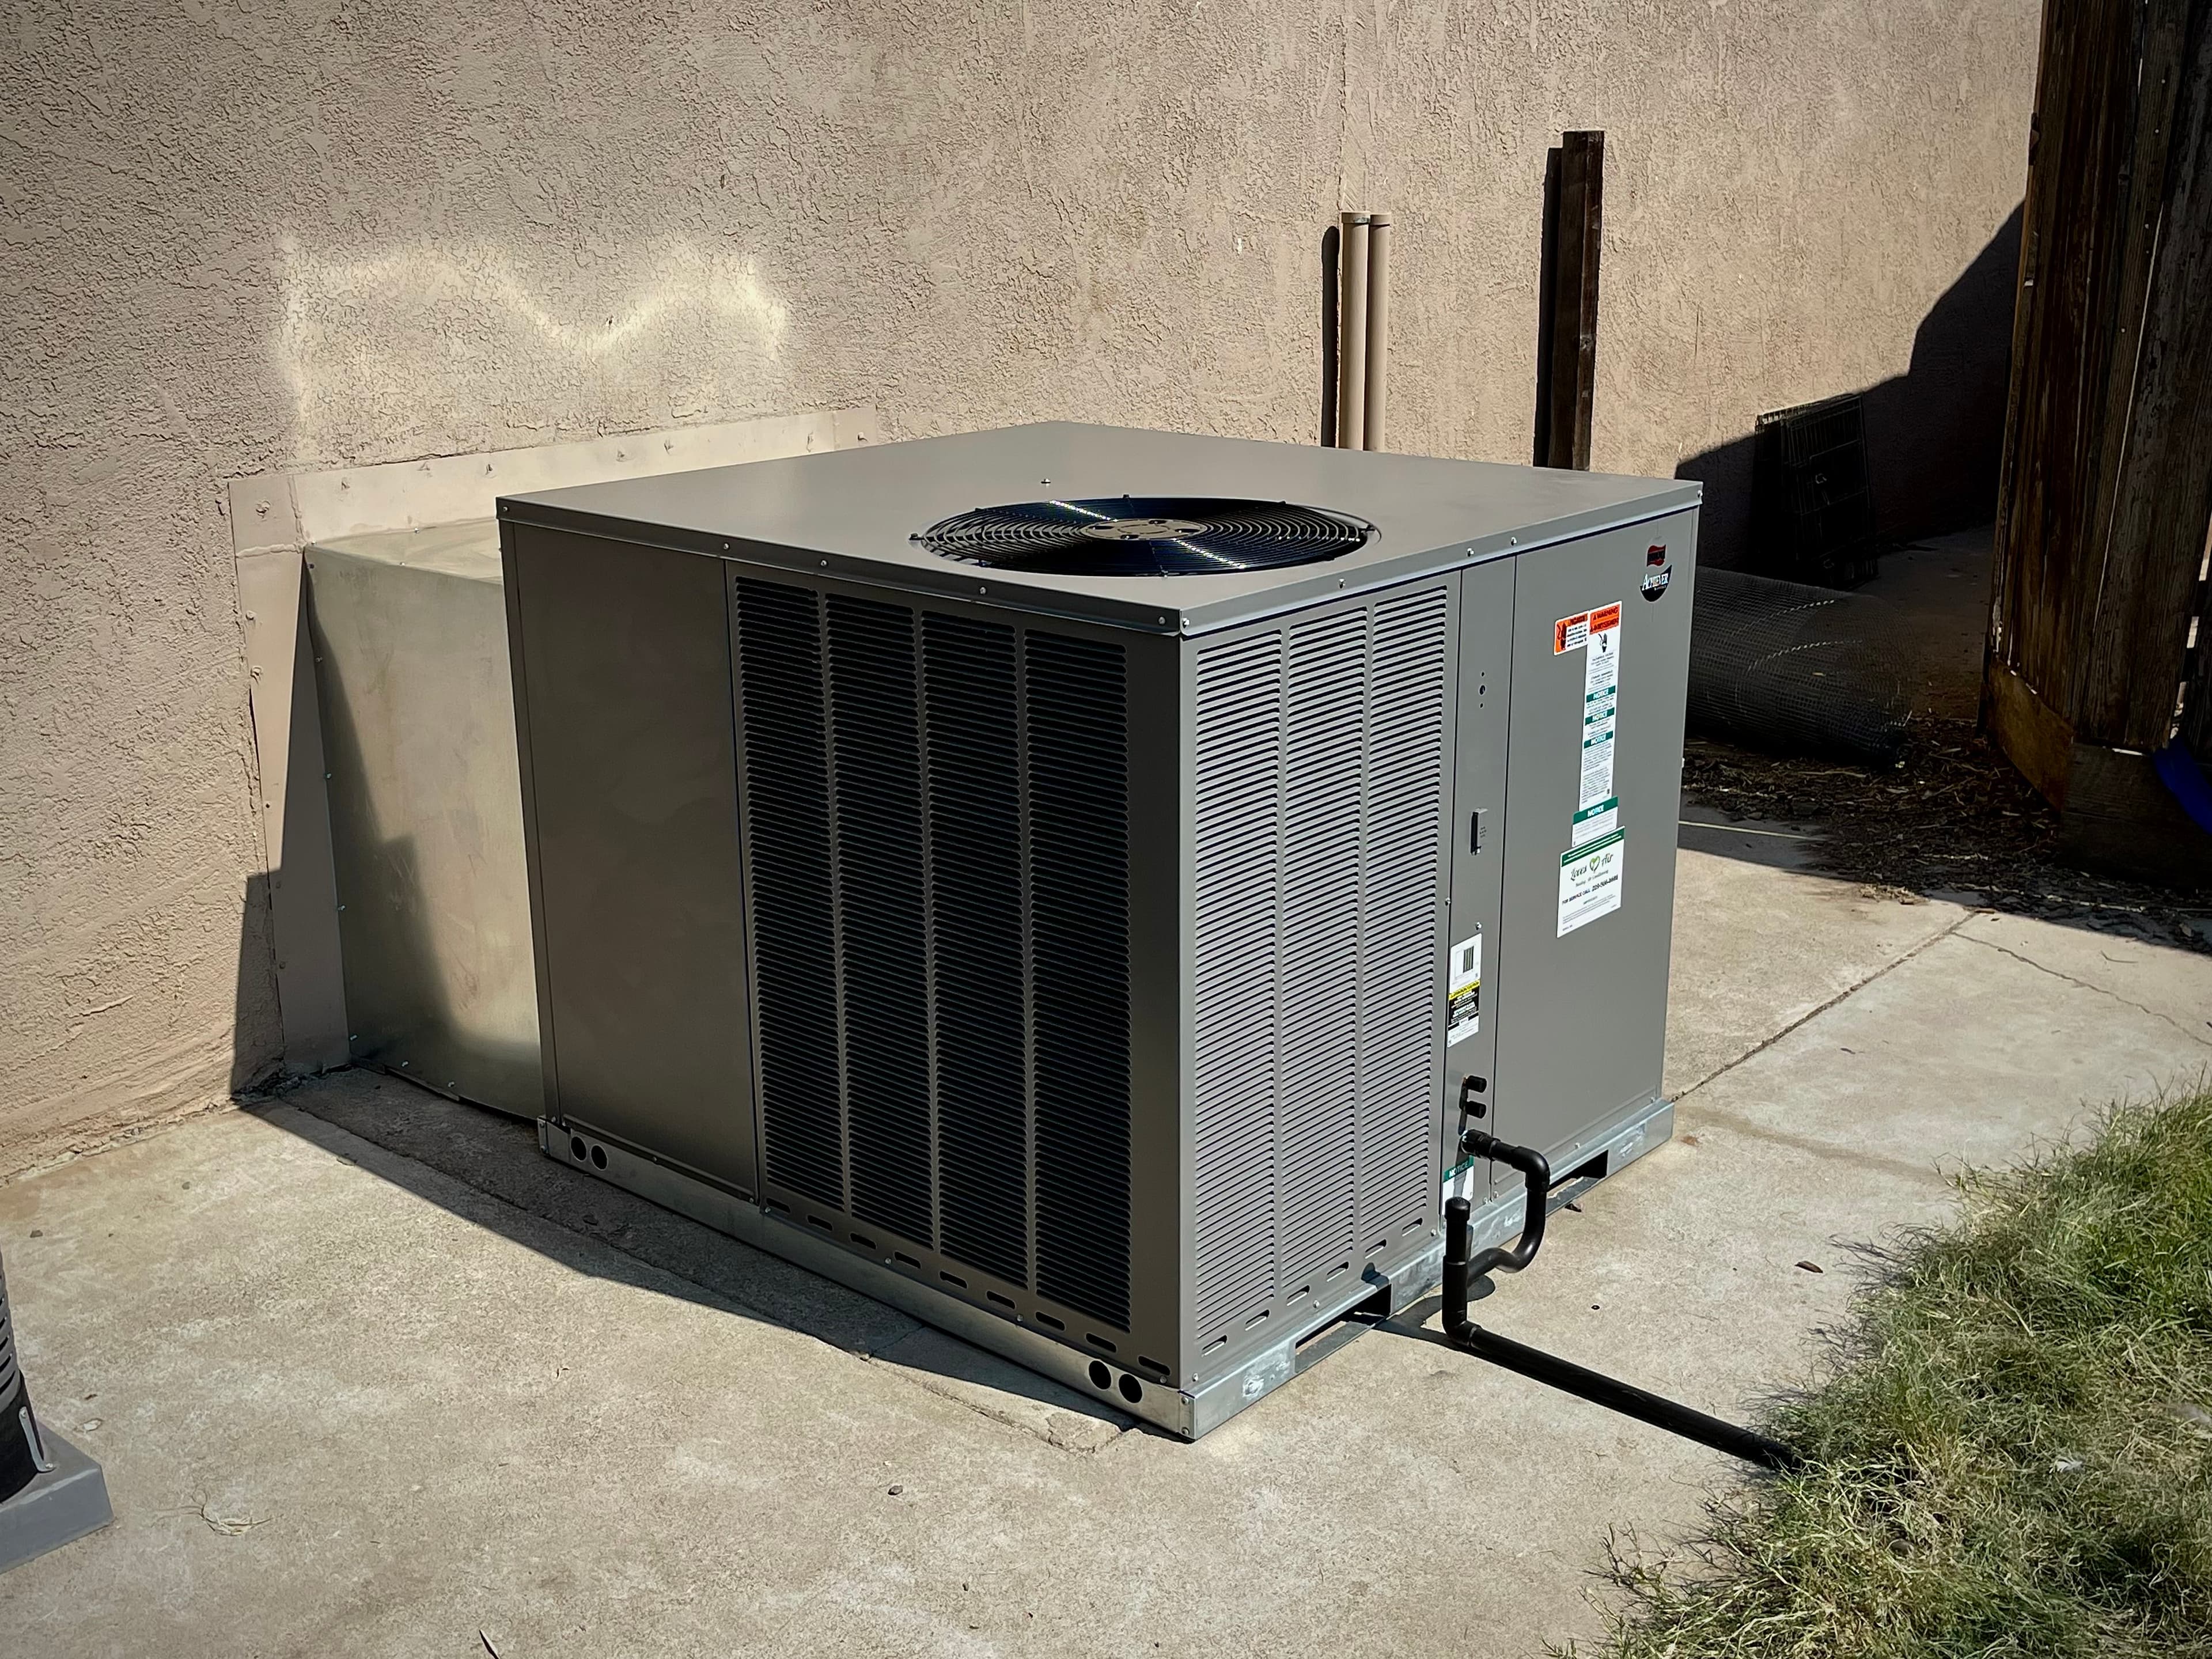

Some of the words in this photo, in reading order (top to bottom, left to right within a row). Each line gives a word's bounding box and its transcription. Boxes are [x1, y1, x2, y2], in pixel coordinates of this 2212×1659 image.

[1597, 607, 1618, 618] WARNING
[1593, 688, 1609, 699] NOTICE
[1592, 710, 1608, 722] NOTICE
[1590, 733, 1607, 745] NOTICE
[1588, 805, 1604, 817] NOTICE
[1449, 1160, 1468, 1178] NOTICE
